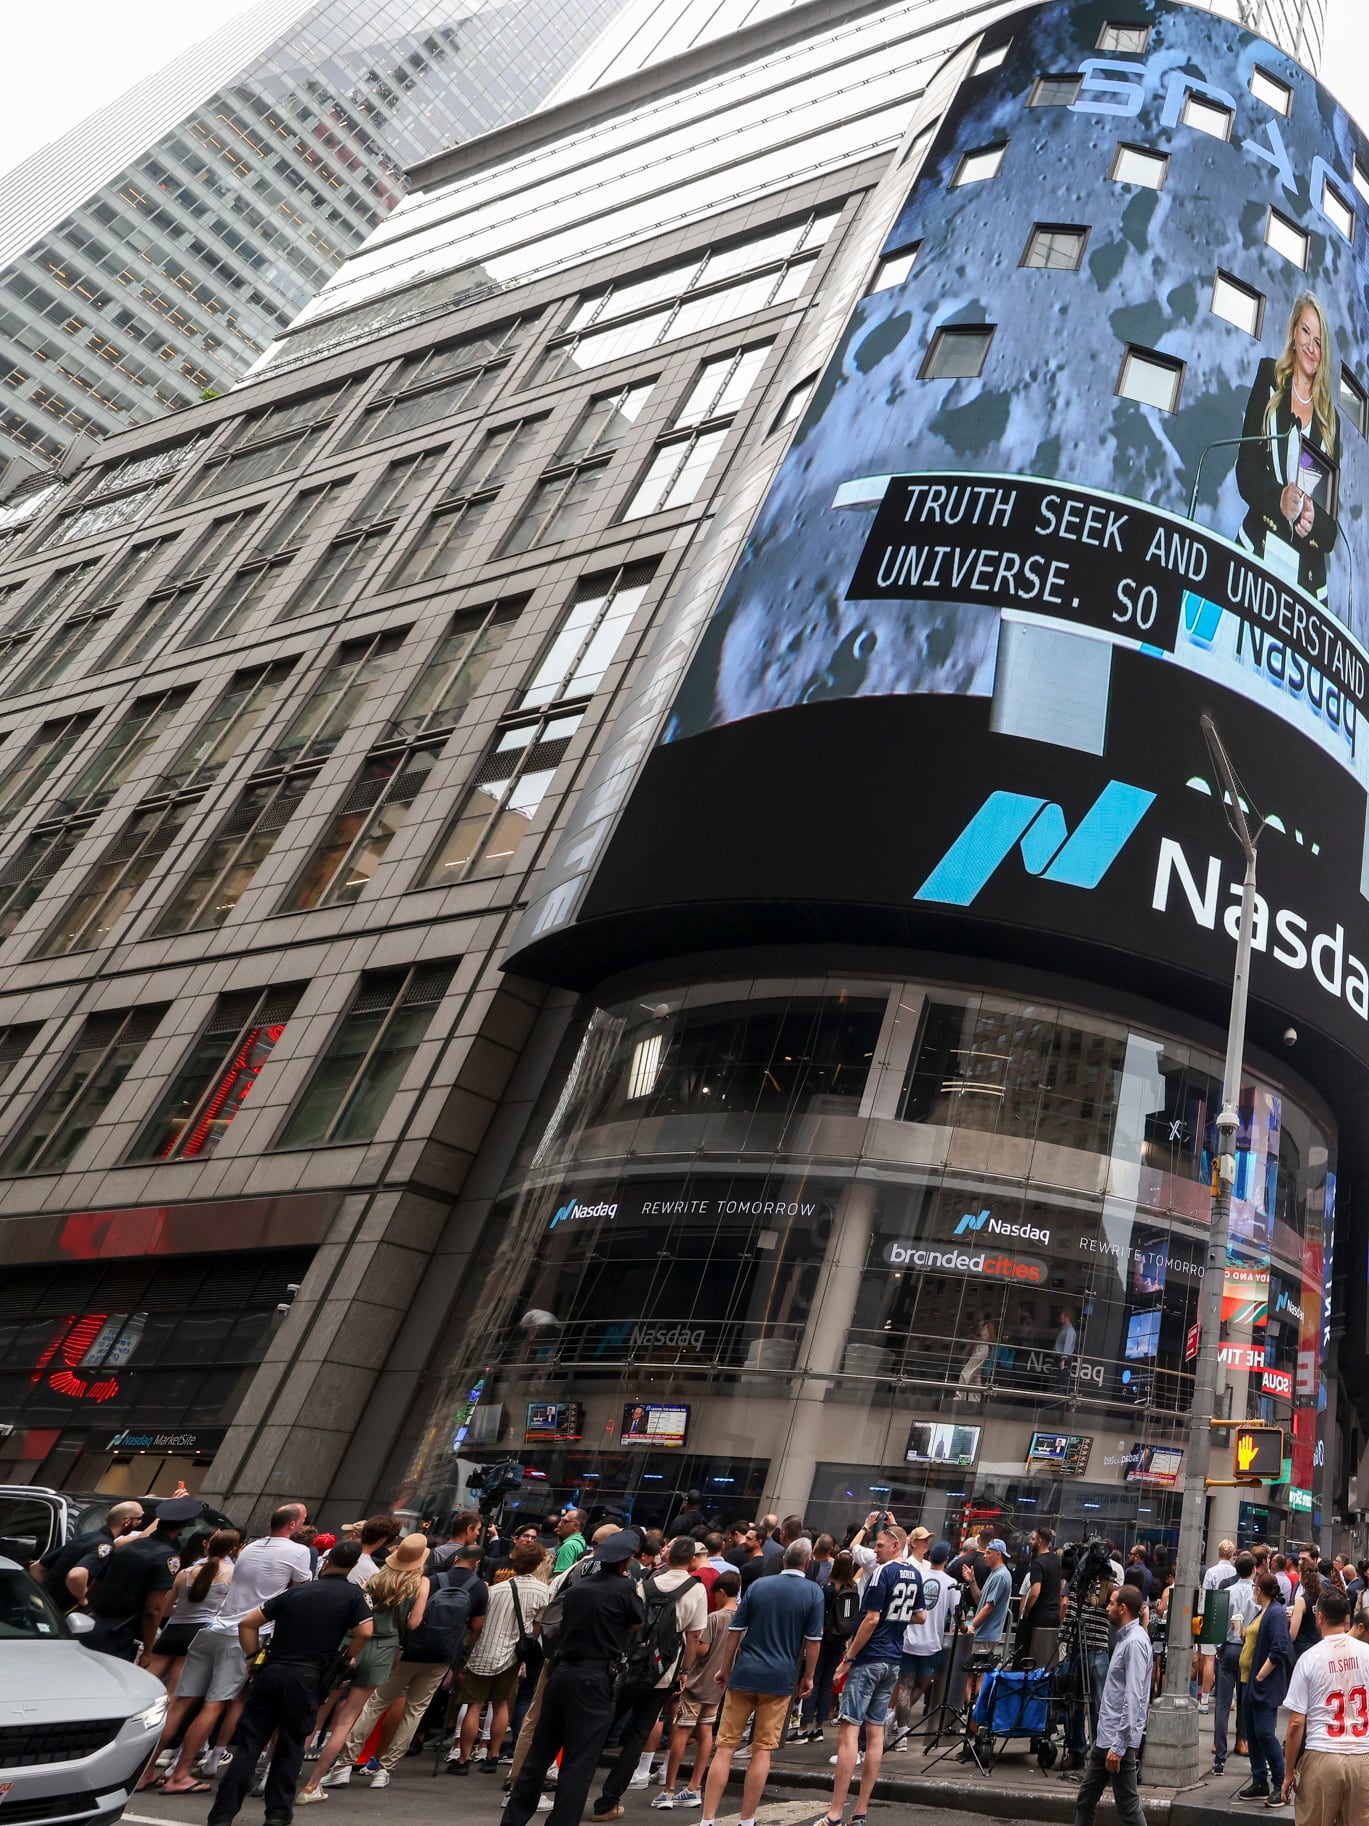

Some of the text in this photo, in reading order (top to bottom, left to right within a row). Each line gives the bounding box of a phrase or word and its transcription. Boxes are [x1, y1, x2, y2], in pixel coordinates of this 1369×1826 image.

[876, 546, 1159, 630] UNIVERSE. SO
[904, 485, 1018, 527] TRUTH
[1035, 494, 1129, 554] SEEK
[1146, 526, 1208, 582] AND
[1227, 560, 1365, 700] UNDERSTAND
[570, 1201, 618, 1219] Nasdaq
[641, 1200, 816, 1217] REWRITE TOMORROW
[988, 1218, 1050, 1245] Nasdaq
[890, 1243, 1041, 1281] brandedcities
[1079, 1237, 1205, 1279] REWRITE TOMORRO
[628, 1325, 705, 1351] Nasdaq
[1027, 1351, 1104, 1387] Nadaq
[123, 1433, 197, 1447] Nasdaq MarketSite
[885, 1582, 918, 1622] 22
[1328, 1656, 1359, 1674] M.SAMI
[1325, 1684, 1369, 1738] 33
